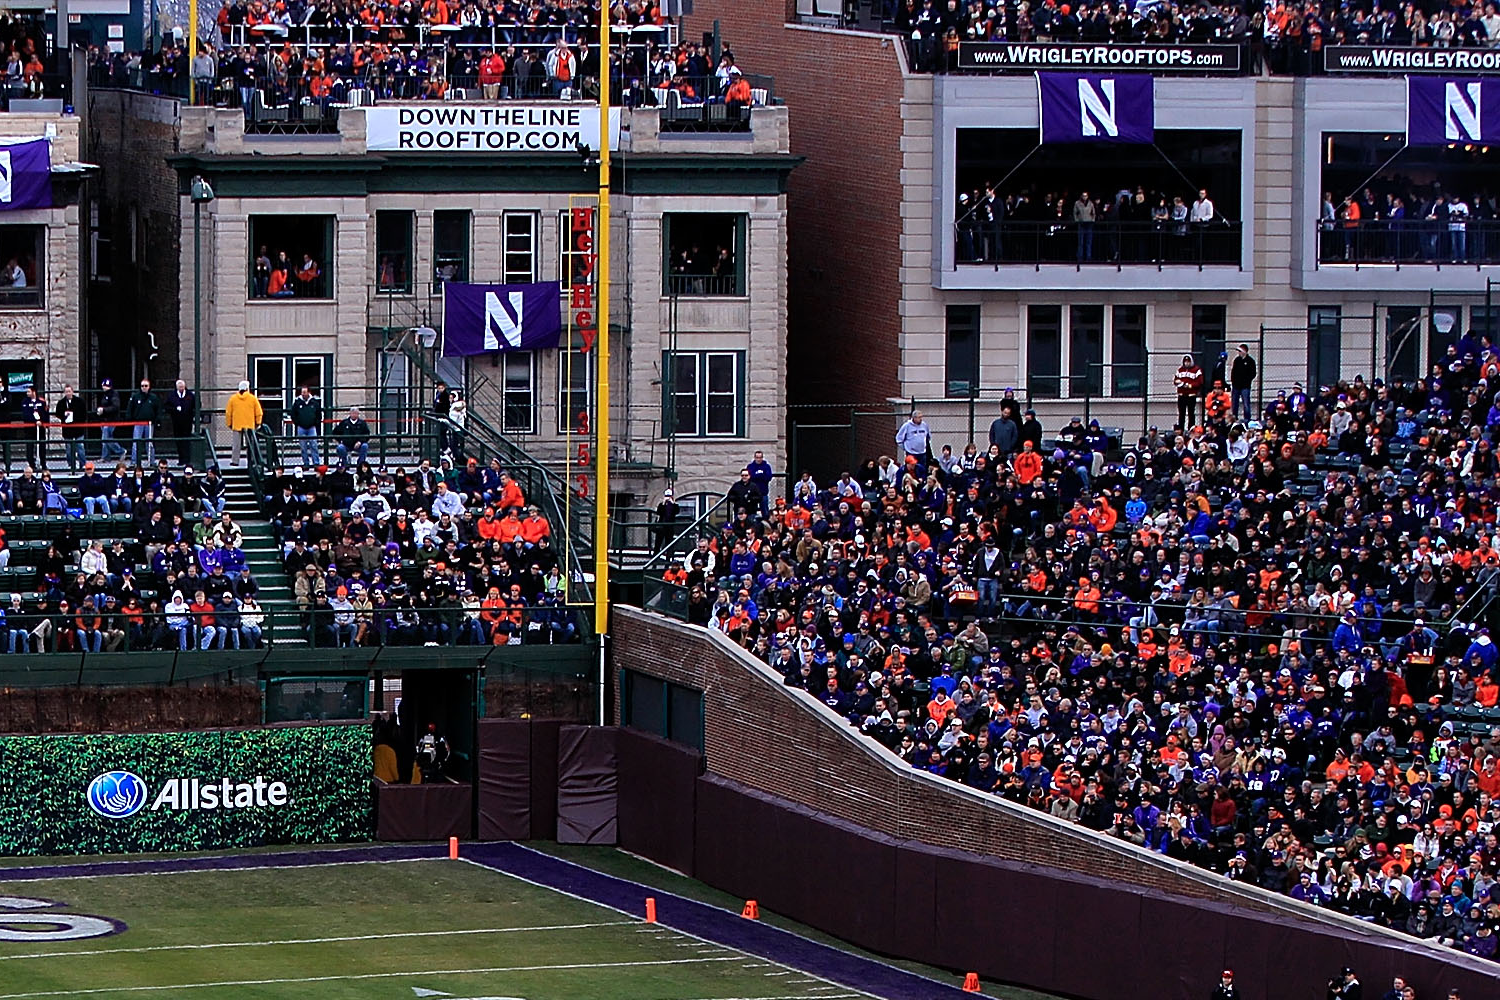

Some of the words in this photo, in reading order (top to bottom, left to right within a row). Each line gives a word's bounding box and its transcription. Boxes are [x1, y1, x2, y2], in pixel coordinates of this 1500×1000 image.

[400, 109, 475, 126] DOWN
[1078, 79, 1118, 137] N
[1445, 82, 1481, 141] N
[399, 131, 580, 149] ROOFTOP.COM
[484, 291, 523, 350] N
[151, 776, 288, 811] Allstate
